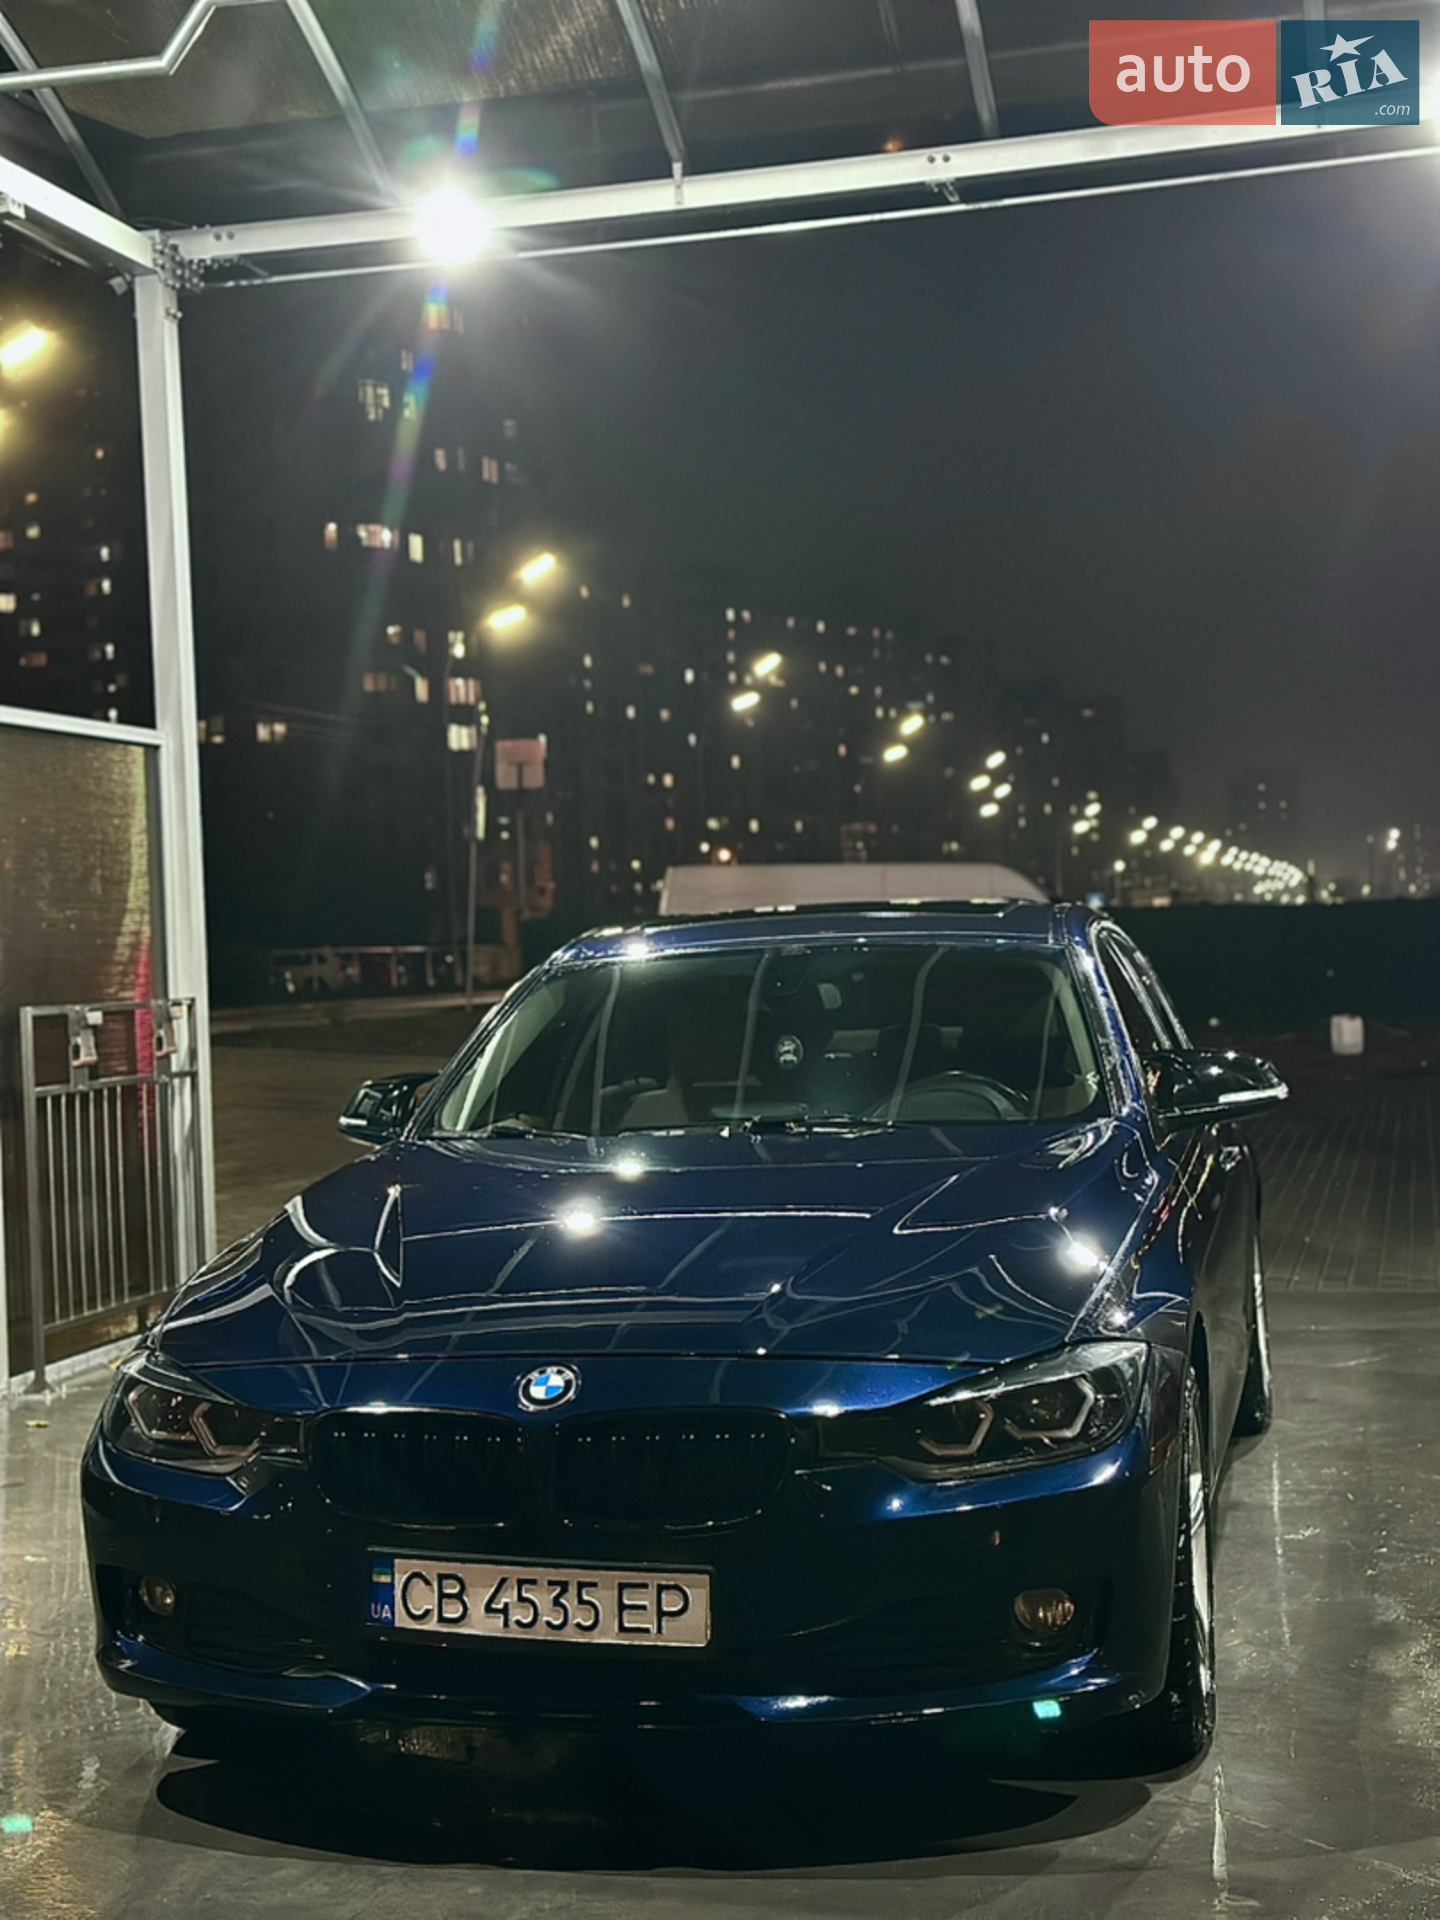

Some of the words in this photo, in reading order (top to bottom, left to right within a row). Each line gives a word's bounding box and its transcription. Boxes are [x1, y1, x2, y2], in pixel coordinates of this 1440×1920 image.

[371, 1603, 392, 1619] UA
[401, 1571, 469, 1624] CB
[484, 1577, 601, 1632] 4535
[616, 1582, 691, 1634] EP
